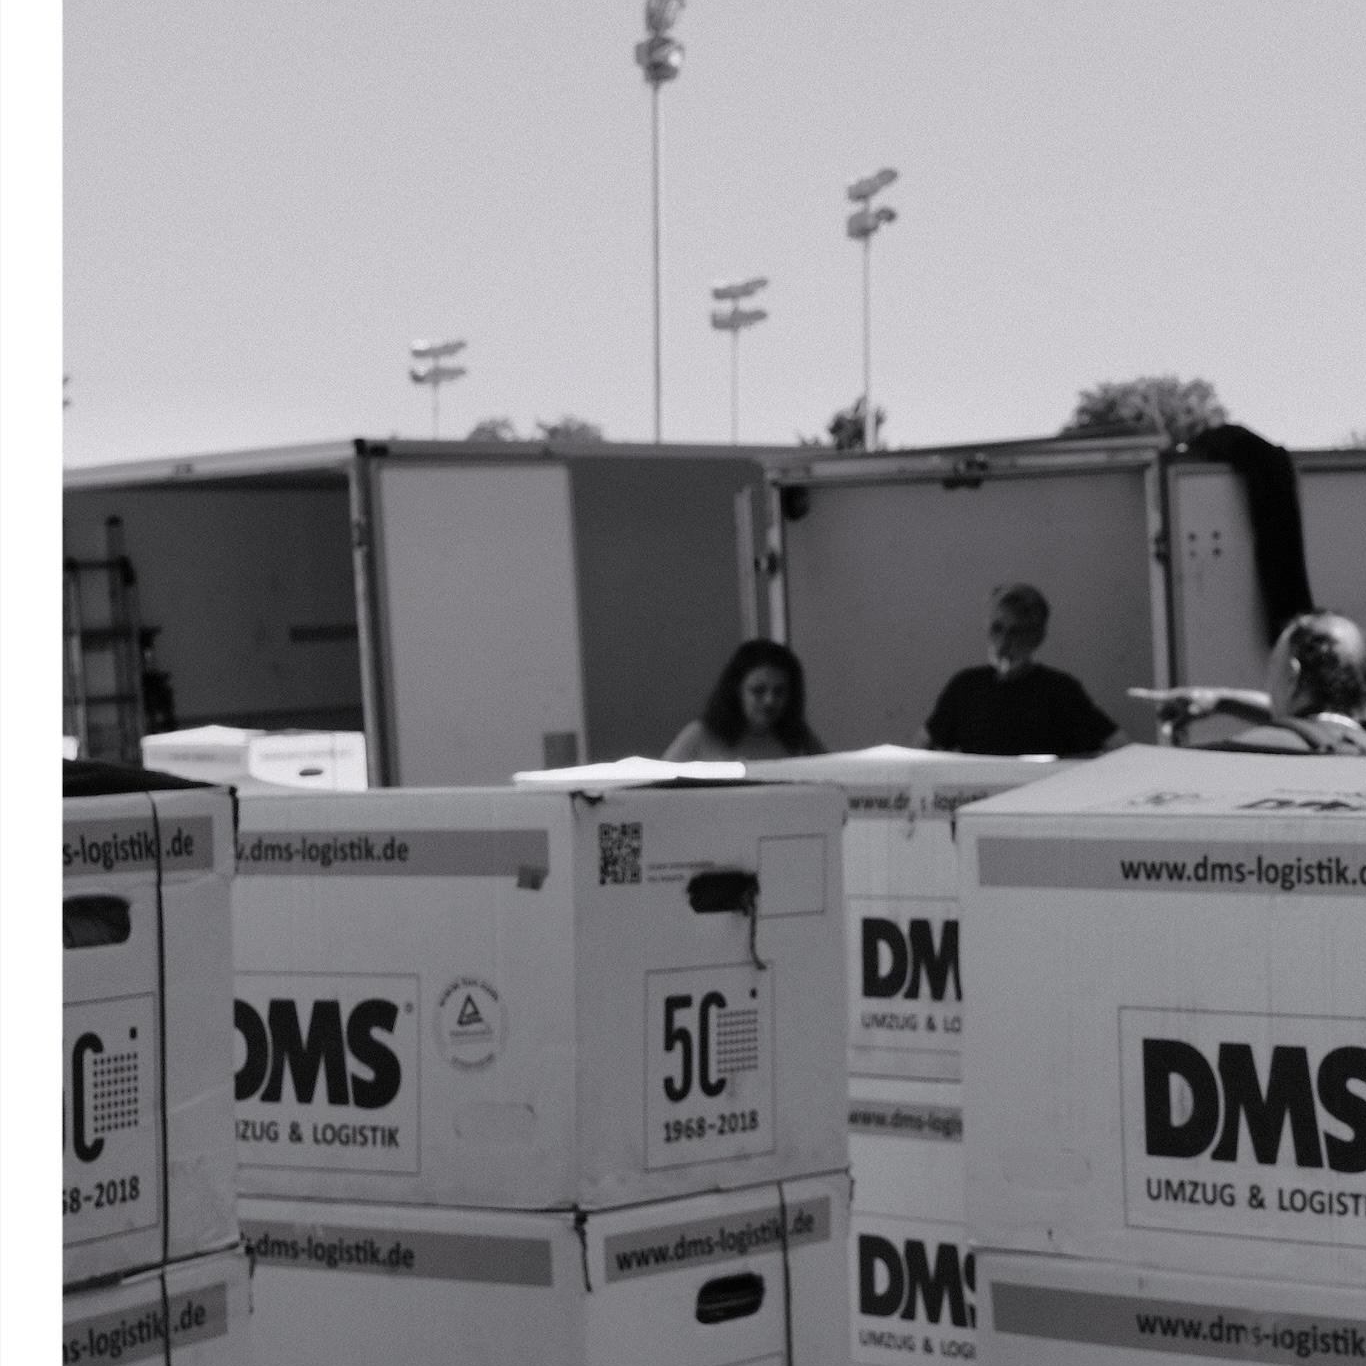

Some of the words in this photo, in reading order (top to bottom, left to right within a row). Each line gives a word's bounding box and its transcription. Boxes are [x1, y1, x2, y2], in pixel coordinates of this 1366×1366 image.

[289, 1122, 304, 1143] &
[313, 1125, 398, 1147] LOGISTIK
[663, 1111, 759, 1143] 1968-2018
[1145, 1178, 1236, 1208] UMZUG
[1248, 1183, 1267, 1211] &
[615, 1211, 815, 1273] www.dms-logistik.de
